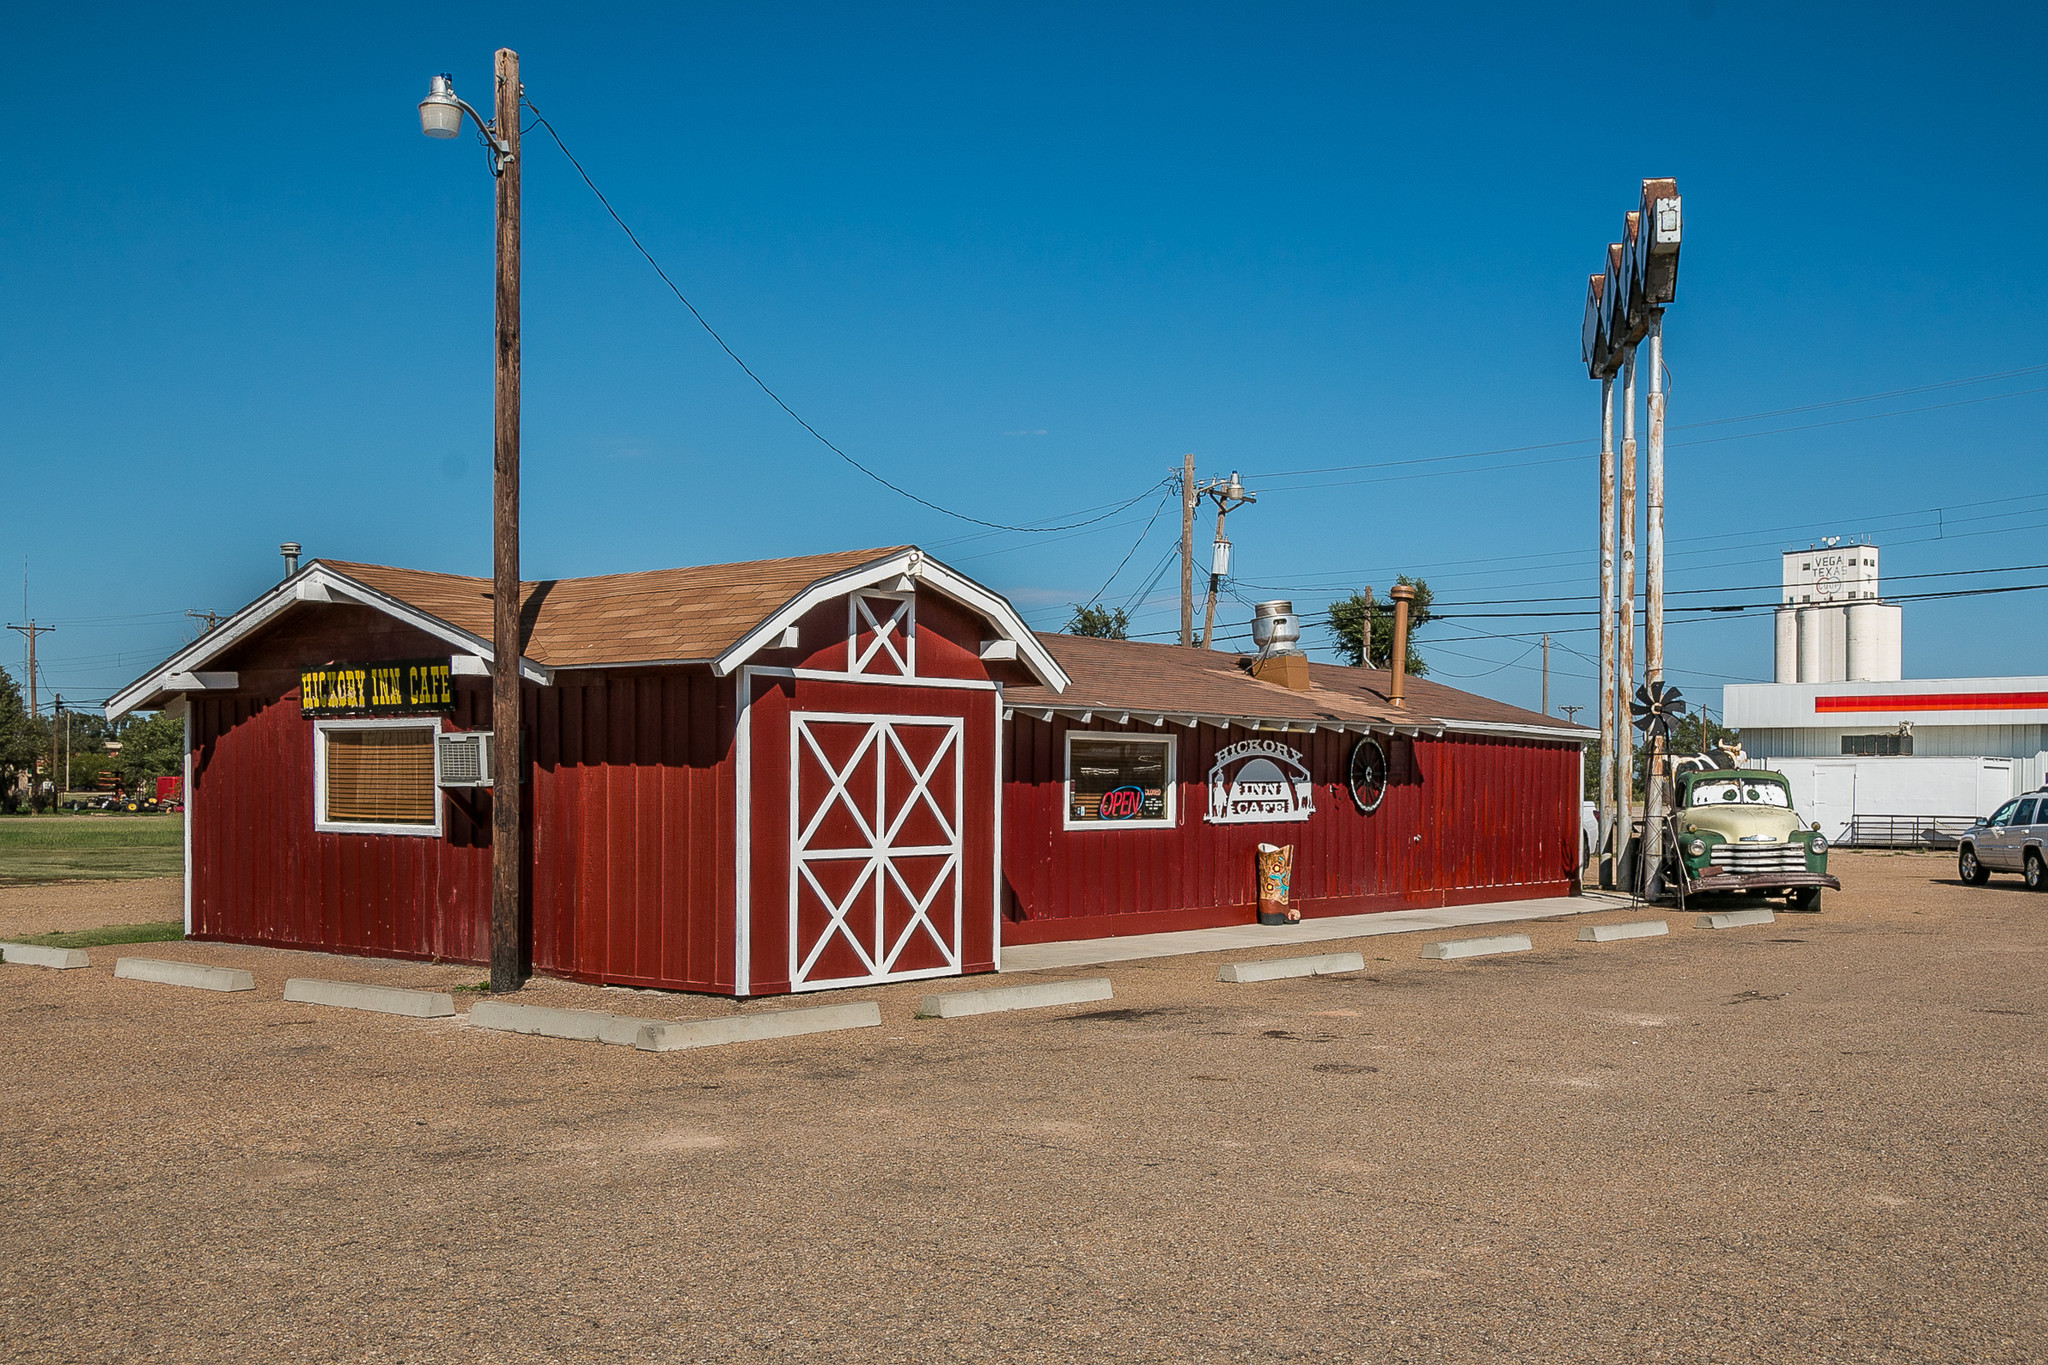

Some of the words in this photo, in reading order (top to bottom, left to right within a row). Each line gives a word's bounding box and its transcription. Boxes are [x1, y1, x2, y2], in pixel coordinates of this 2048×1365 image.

[1815, 556, 1843, 567] VEGA
[1812, 566, 1847, 577] TEXAS
[302, 670, 366, 709] HICKORY
[371, 667, 402, 705] INN
[410, 665, 451, 705] CAFE
[1215, 739, 1303, 764] HICKORY
[1241, 783, 1280, 795] INN
[1101, 791, 1140, 816] OPEN
[1237, 802, 1286, 814] CAFE
